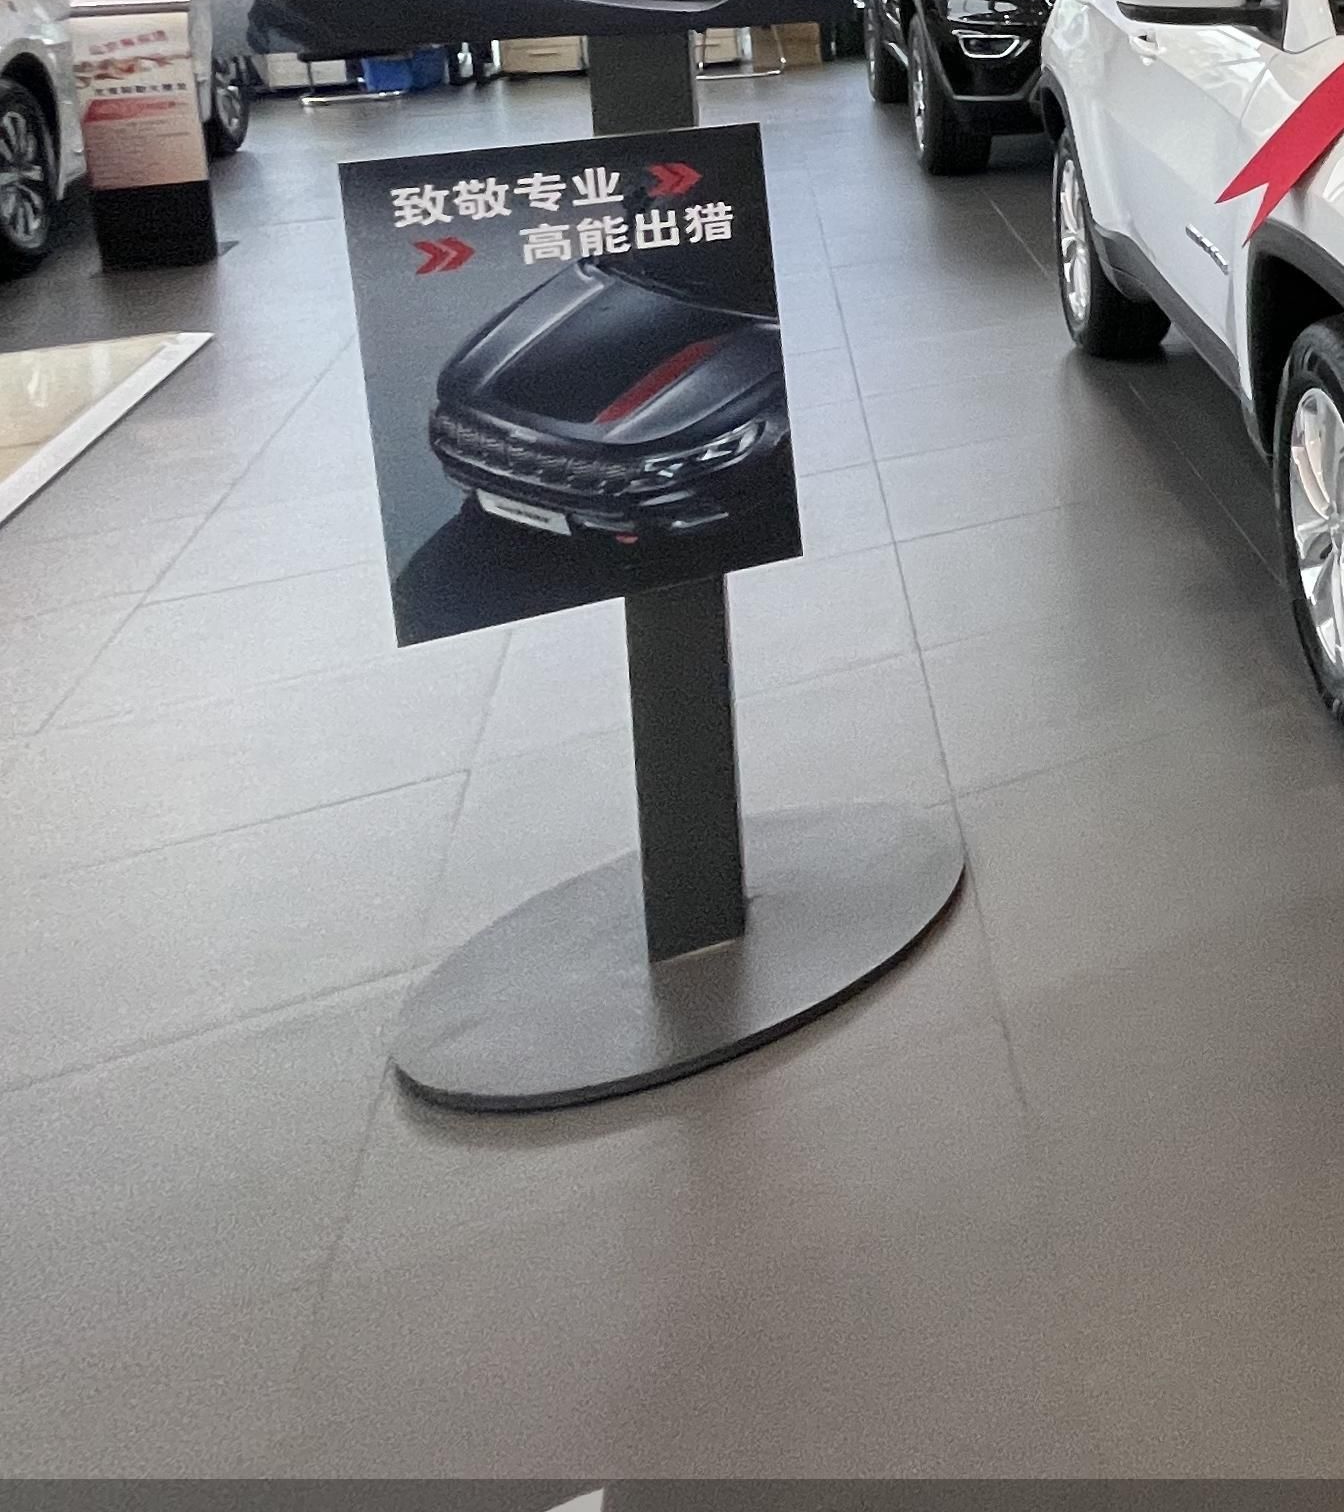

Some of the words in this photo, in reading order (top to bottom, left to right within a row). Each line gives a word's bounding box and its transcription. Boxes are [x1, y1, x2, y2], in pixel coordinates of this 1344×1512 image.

[390, 166, 625, 228] 致敬专业
[518, 202, 735, 265] 高能出猎
